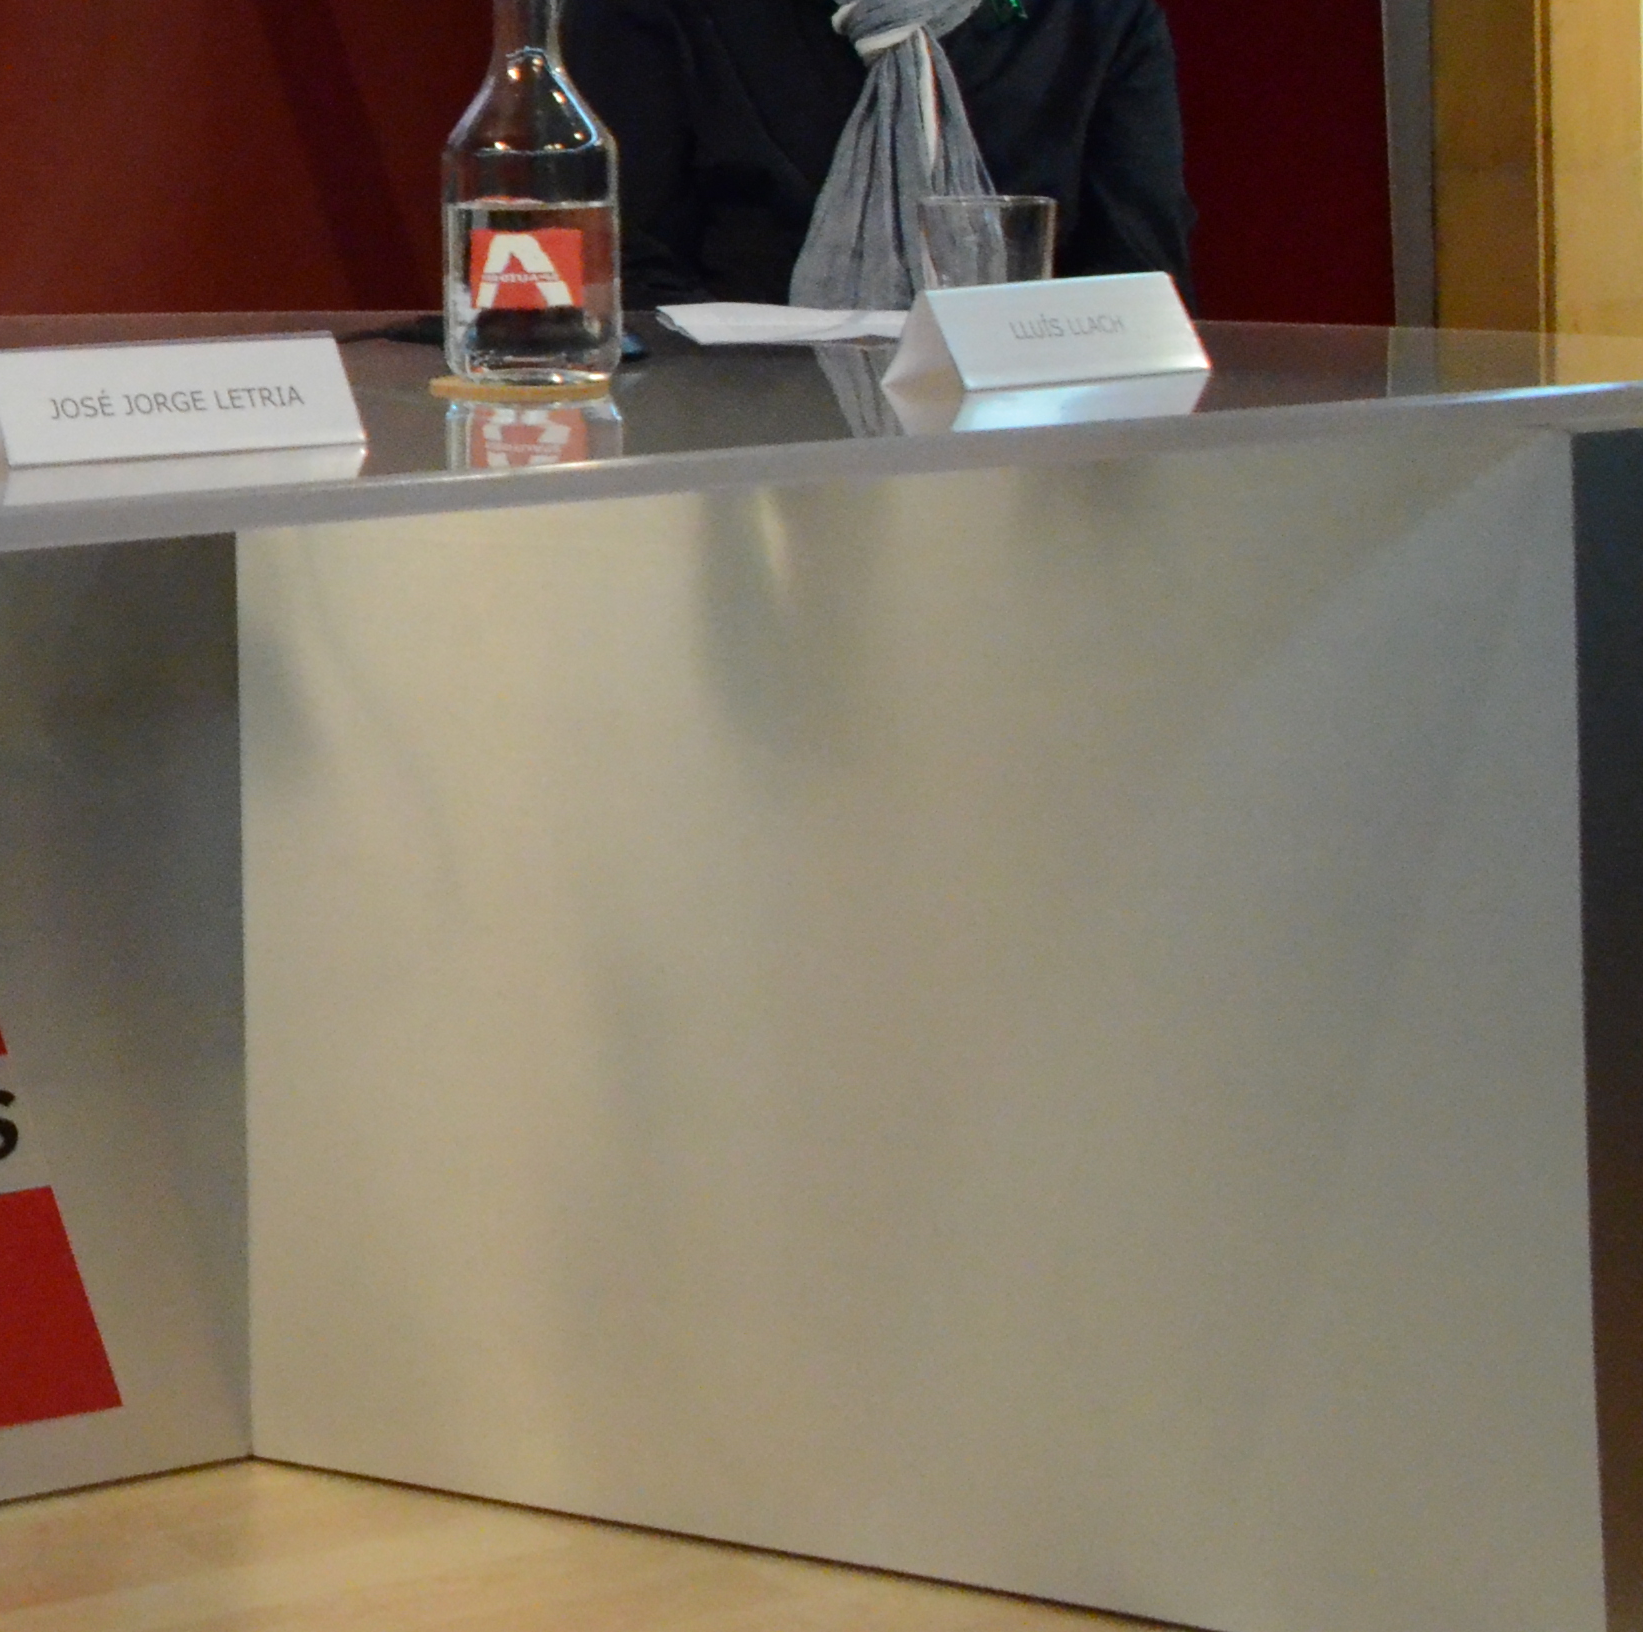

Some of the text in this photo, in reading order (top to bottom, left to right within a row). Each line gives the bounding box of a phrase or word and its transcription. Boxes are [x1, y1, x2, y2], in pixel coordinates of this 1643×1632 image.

[50, 385, 305, 420] JOSÉ JORGE LETRIA
